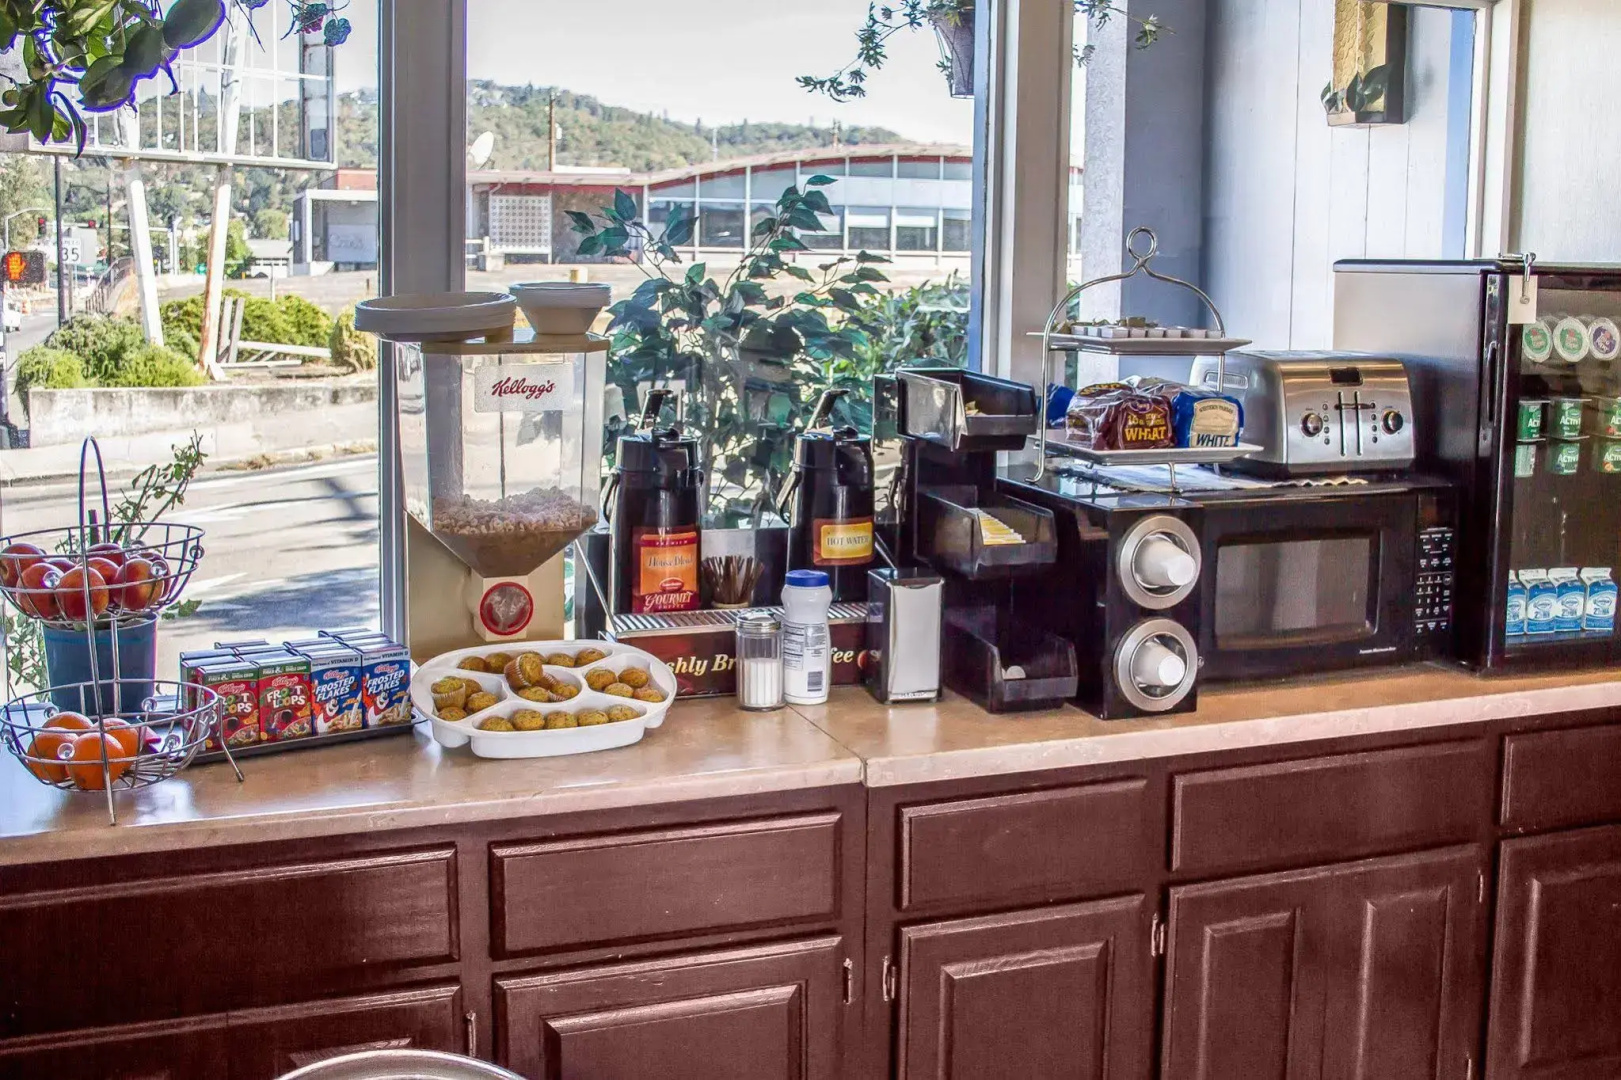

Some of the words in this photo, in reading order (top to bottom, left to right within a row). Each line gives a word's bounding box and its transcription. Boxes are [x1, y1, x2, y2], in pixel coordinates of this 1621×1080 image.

[62, 247, 80, 262] 35
[491, 376, 555, 399] Kellogg's
[1125, 426, 1167, 441] WHEAT
[1196, 433, 1232, 448] WHITE
[827, 537, 843, 546] HOT
[846, 535, 869, 545] WATER
[648, 556, 672, 567] House
[643, 591, 693, 611] GOURMET
[665, 656, 708, 676] shly
[315, 676, 355, 696] FROSTED
[367, 669, 405, 688] FROSTED
[316, 684, 350, 702] FLAKES
[368, 679, 401, 696] FLAKES
[272, 695, 306, 709] LOOPS
